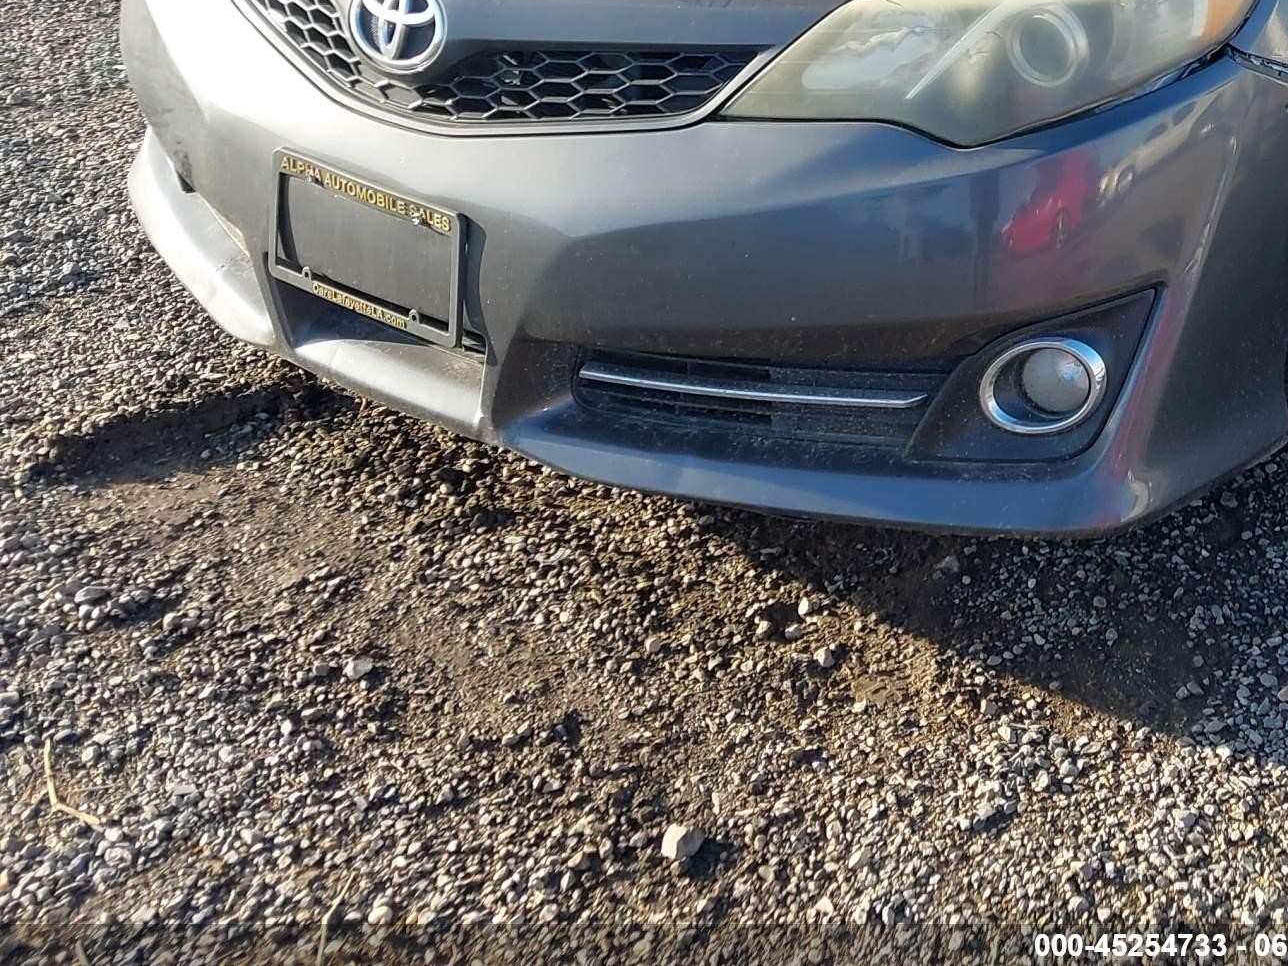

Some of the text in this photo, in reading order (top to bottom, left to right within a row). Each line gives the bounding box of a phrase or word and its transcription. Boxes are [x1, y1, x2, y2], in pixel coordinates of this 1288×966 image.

[281, 156, 450, 232] ALPHA AUTOMOBILE SALES
